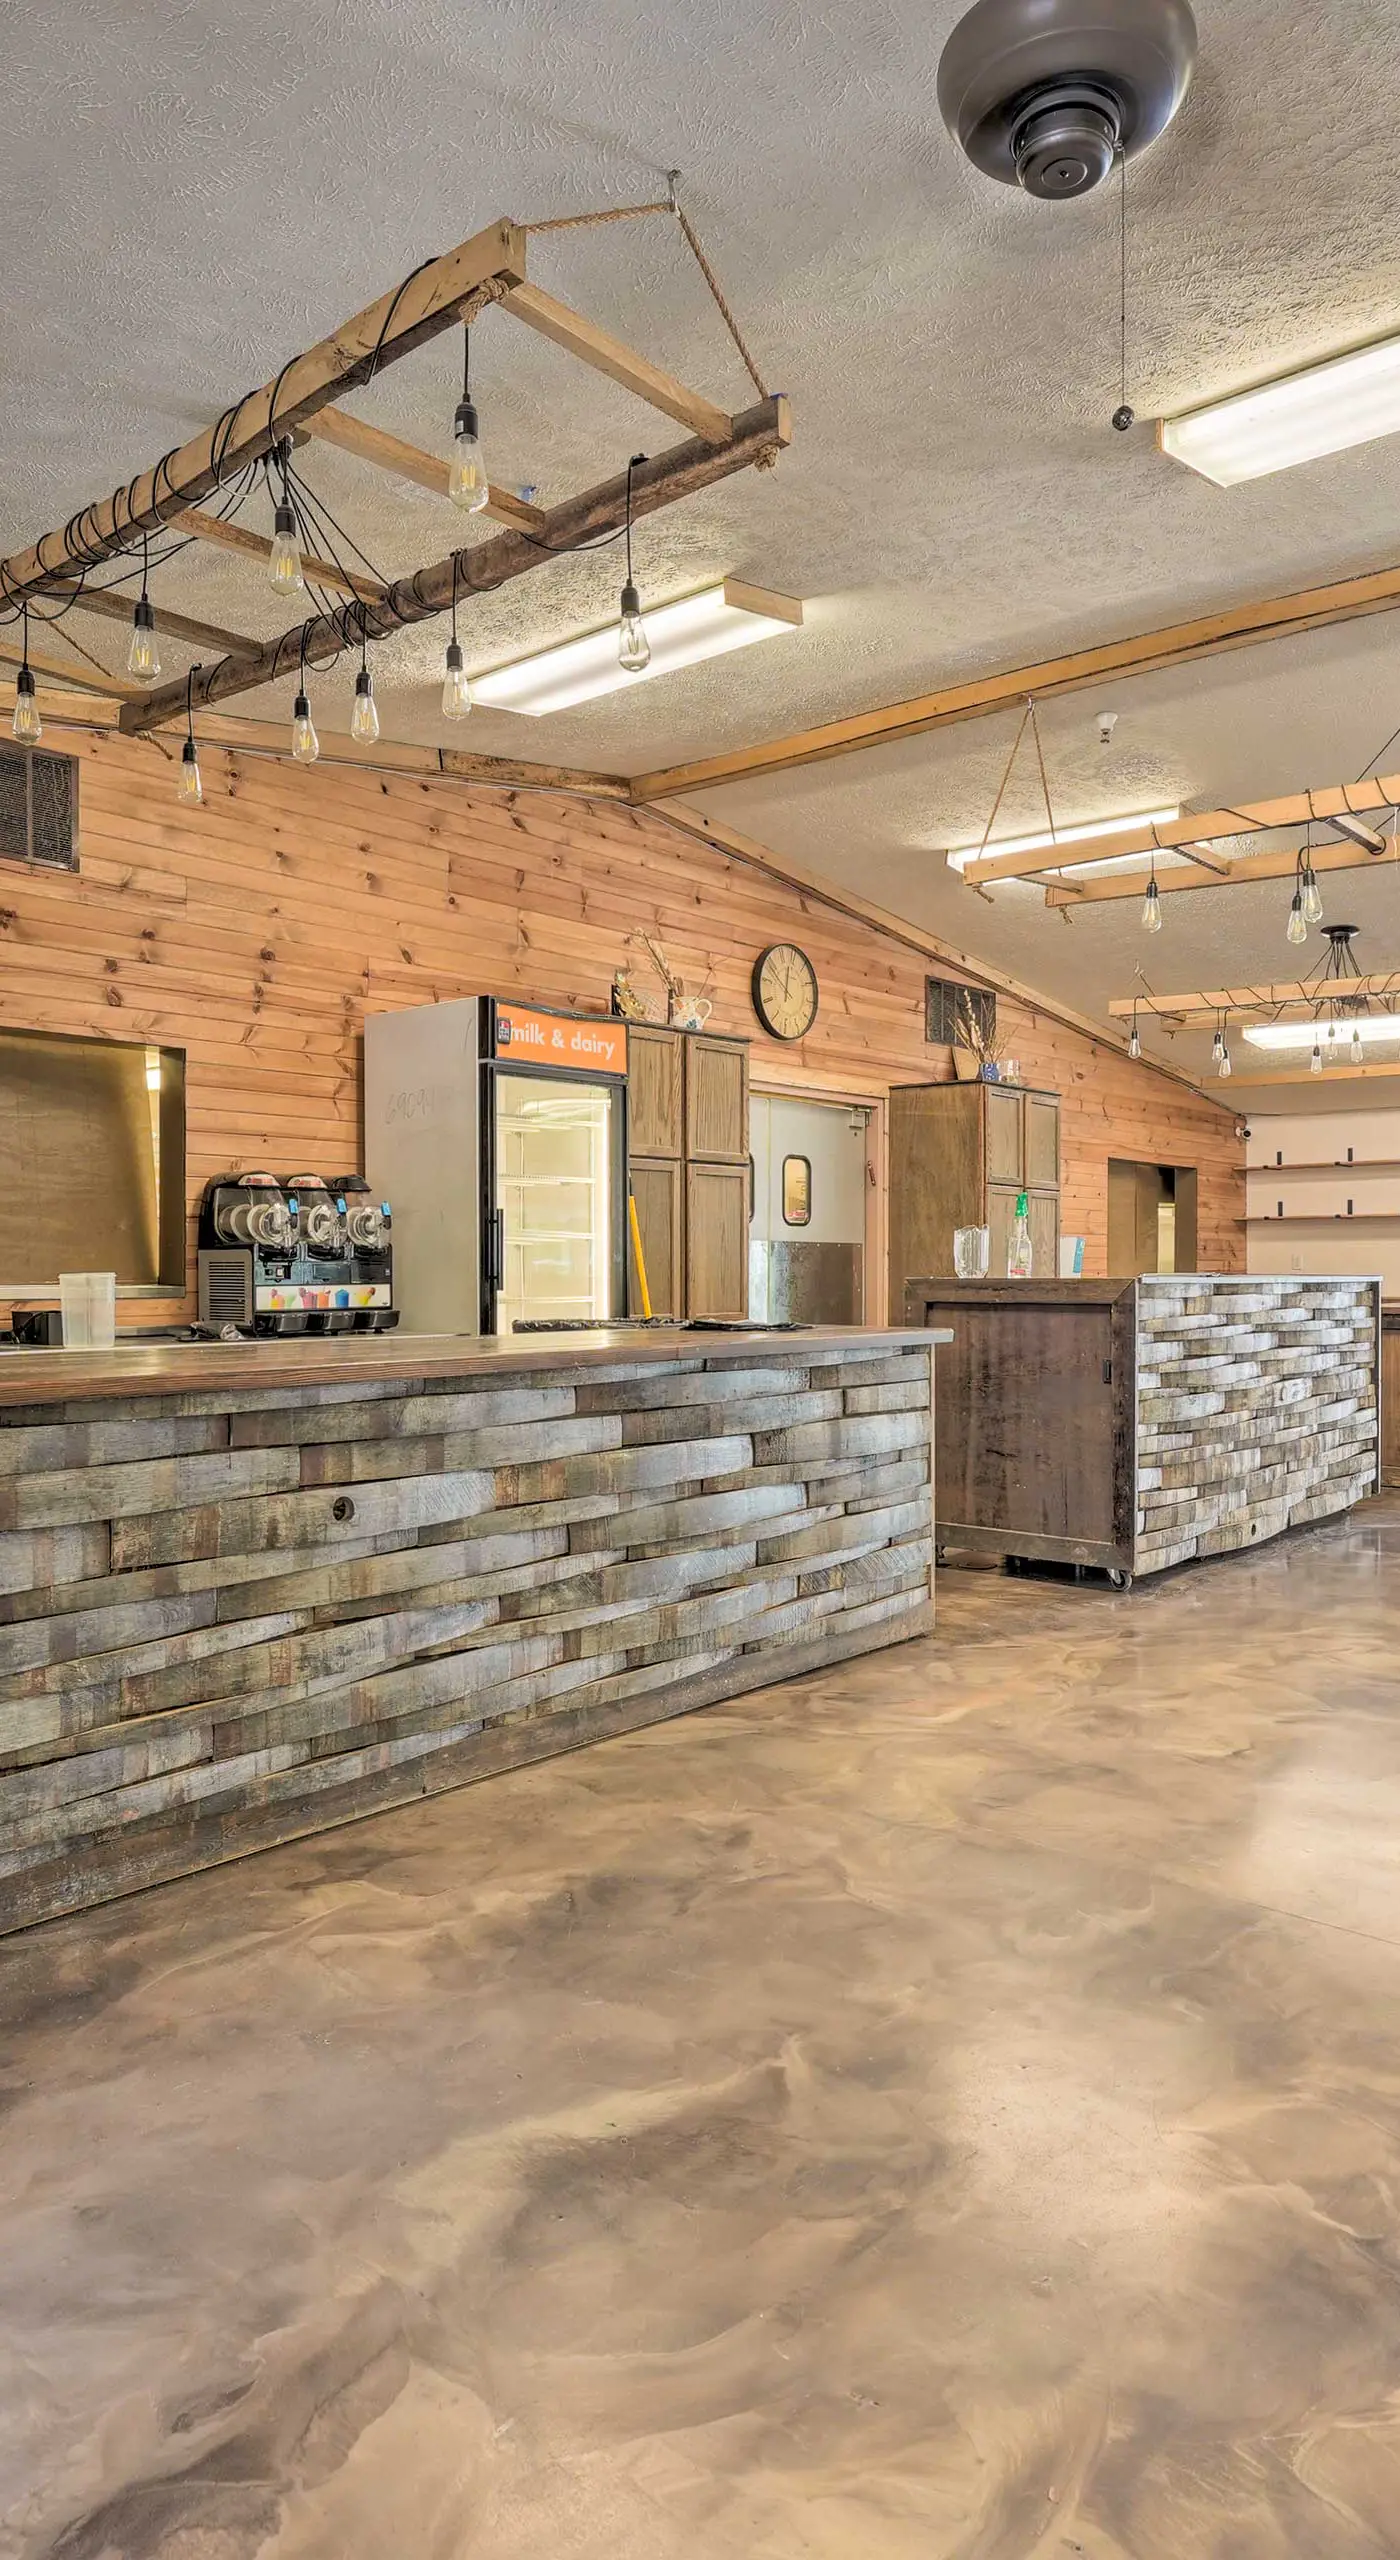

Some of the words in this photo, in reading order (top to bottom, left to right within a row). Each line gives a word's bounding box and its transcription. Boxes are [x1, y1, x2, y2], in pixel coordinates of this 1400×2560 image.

[511, 1022, 545, 1045] milk
[551, 1028, 566, 1048] &
[571, 1031, 615, 1060] dairy
